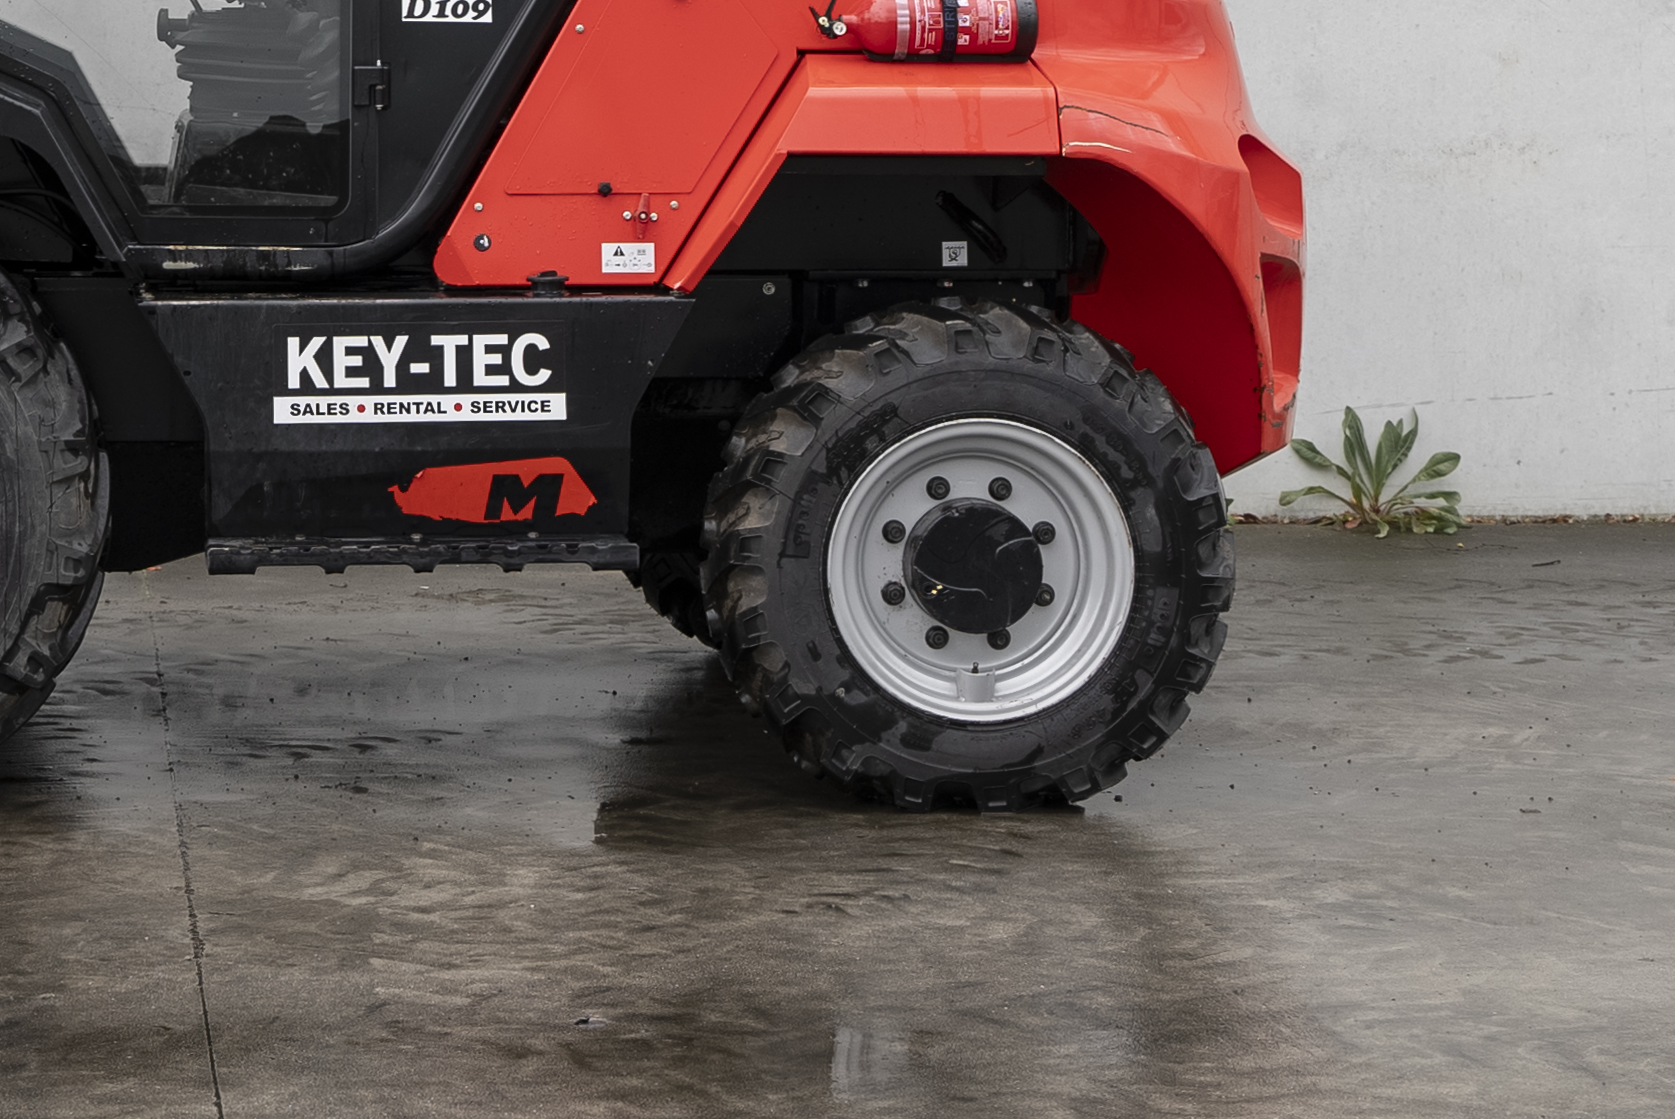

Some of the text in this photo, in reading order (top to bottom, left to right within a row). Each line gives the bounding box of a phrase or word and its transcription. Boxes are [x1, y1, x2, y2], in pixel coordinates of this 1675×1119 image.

[287, 333, 552, 388] KEY-TEC
[290, 399, 551, 416] SALES RENTAL SERVICE
[484, 474, 564, 520] M
